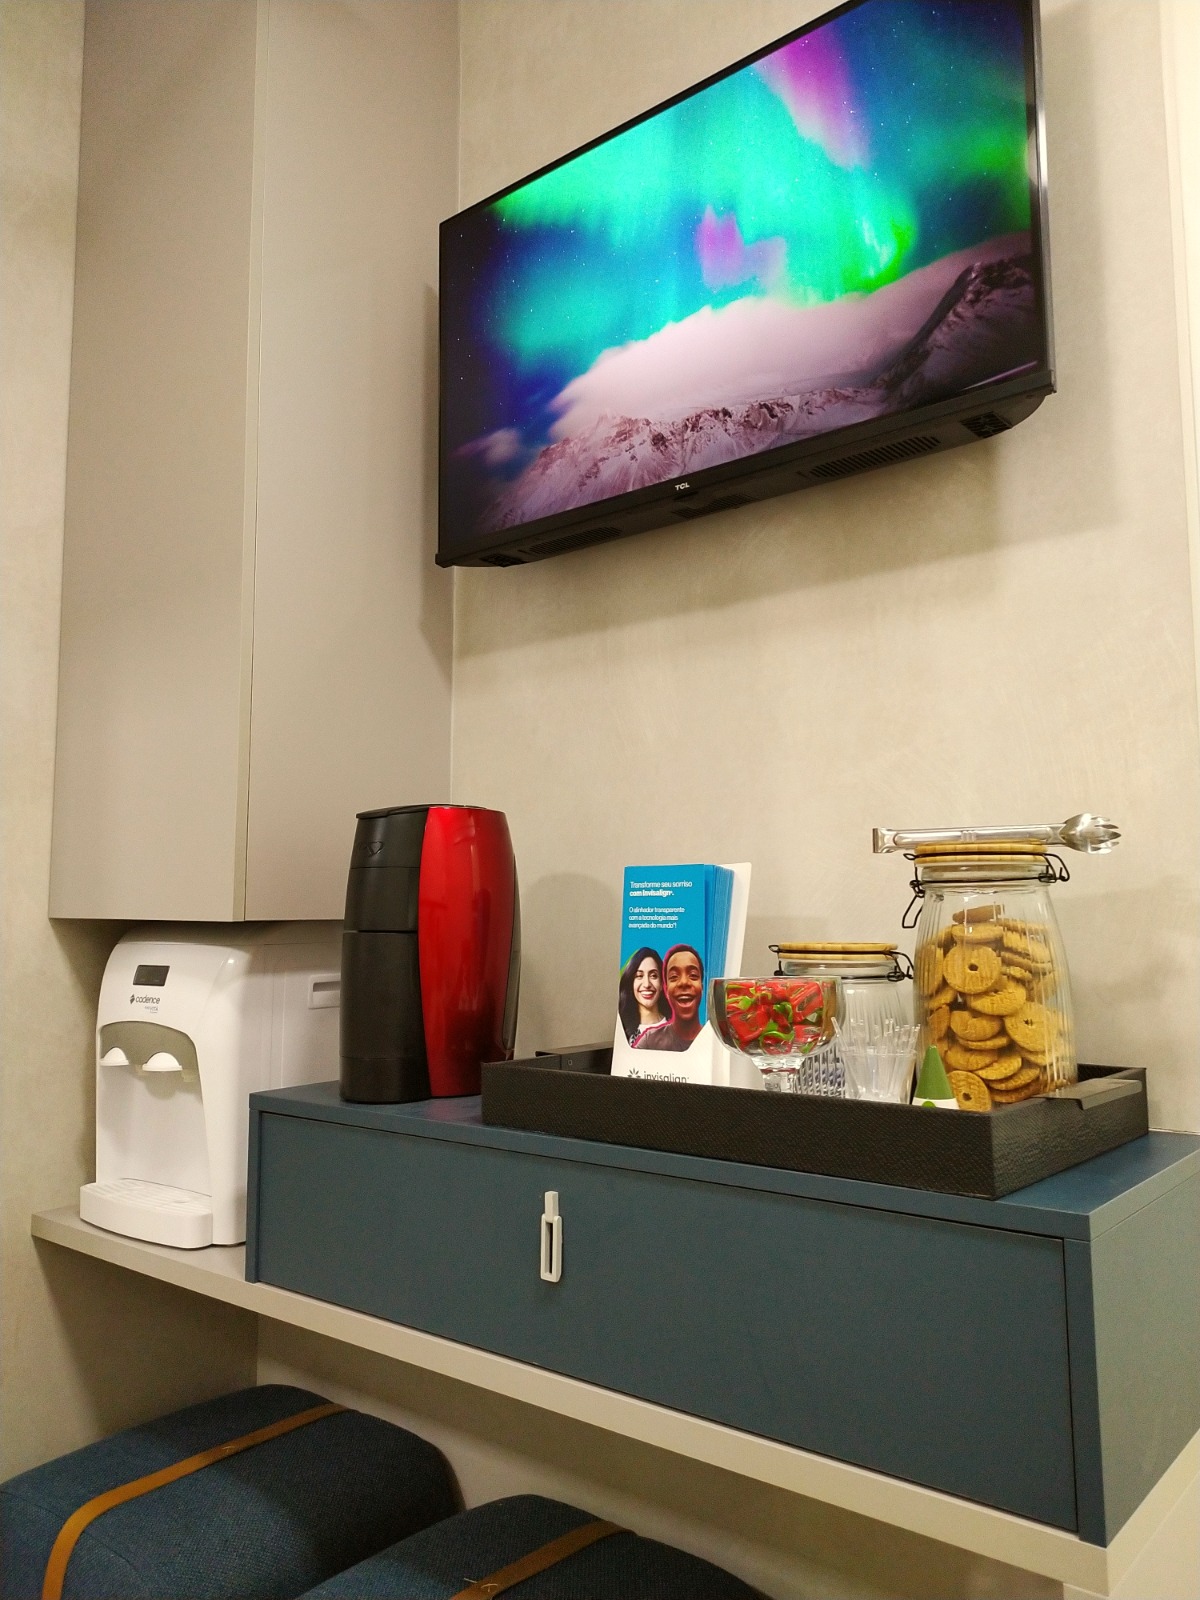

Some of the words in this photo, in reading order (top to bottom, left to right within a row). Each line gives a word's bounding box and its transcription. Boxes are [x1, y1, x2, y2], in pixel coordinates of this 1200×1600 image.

[675, 482, 690, 491] TCL
[630, 881, 660, 889] Transforme
[672, 880, 693, 888] sorriso
[642, 914, 666, 922] tecnologia
[135, 994, 161, 1004] cadence
